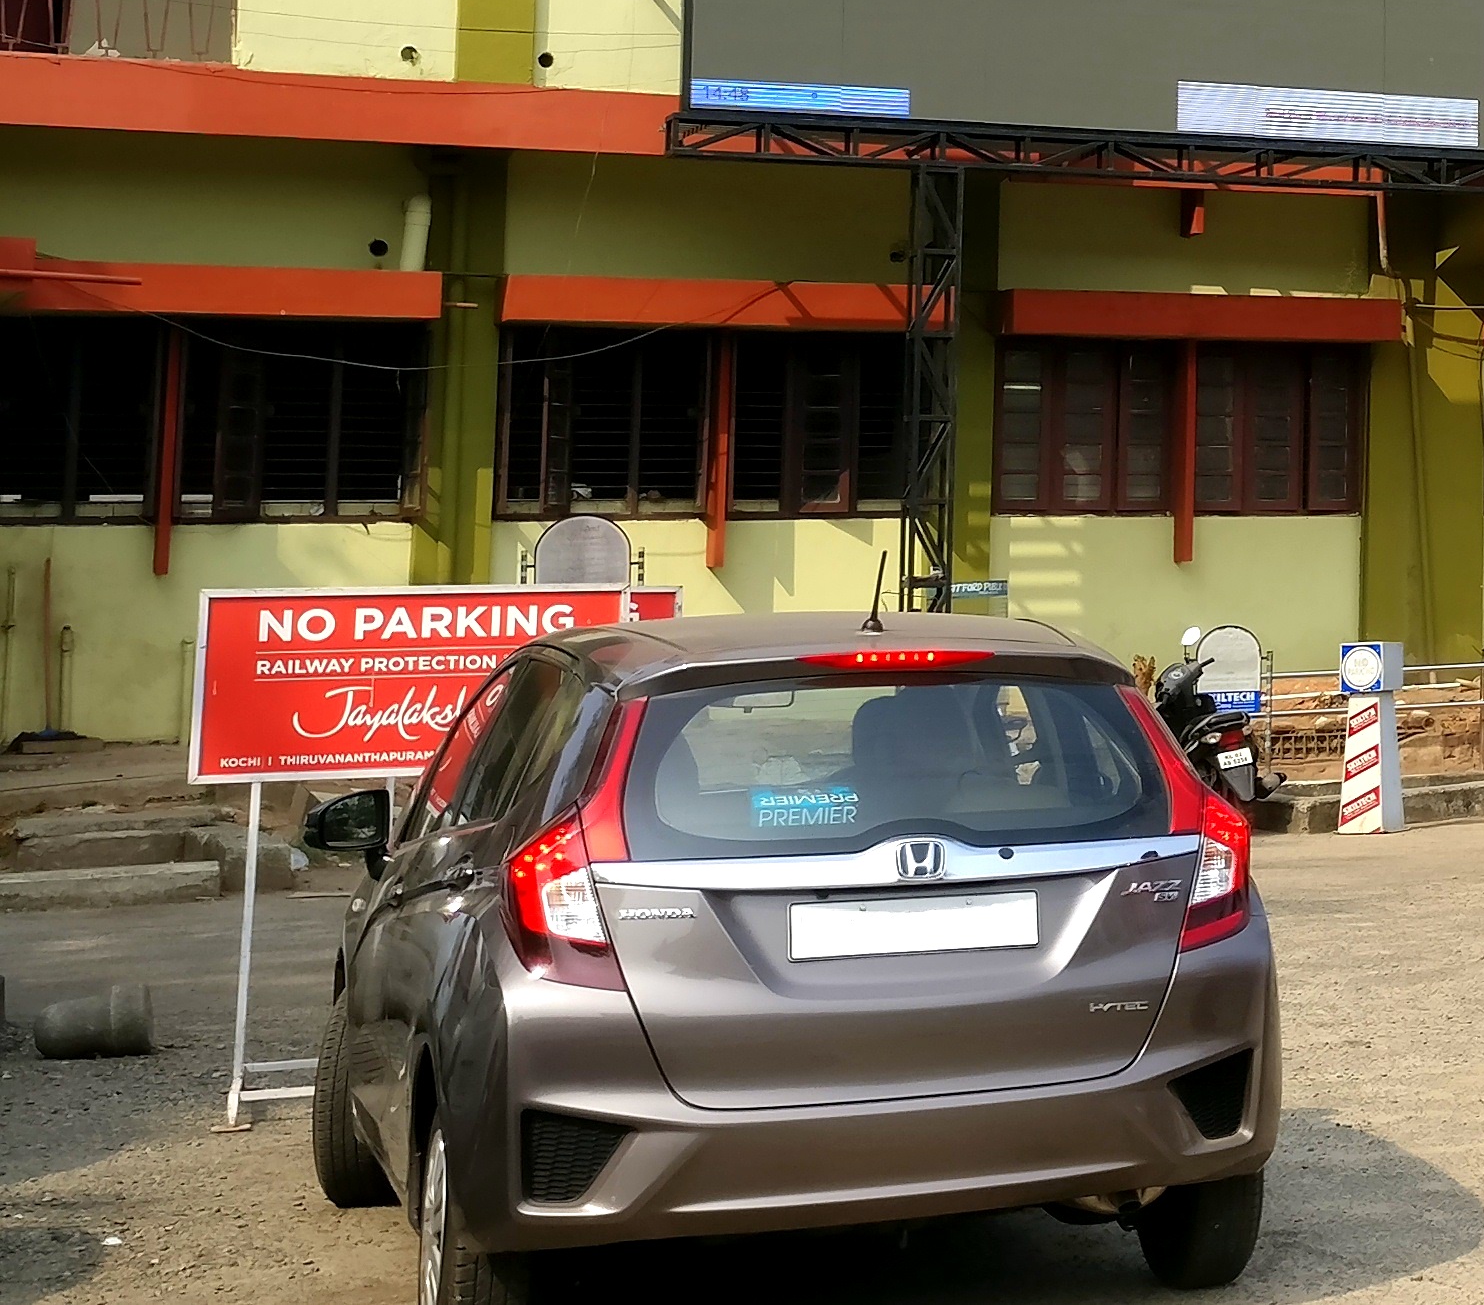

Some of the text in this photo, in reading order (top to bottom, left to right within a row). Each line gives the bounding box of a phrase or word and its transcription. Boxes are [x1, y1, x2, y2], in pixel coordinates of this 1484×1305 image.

[259, 604, 574, 642] NO PARKING
[256, 653, 497, 675] RAILWAY PROTECTION
[220, 757, 261, 768] KOCHI
[279, 751, 435, 766] THIRUVANANTHAPURAM
[758, 806, 858, 827] PREMIER
[1120, 879, 1183, 897] JAZZ
[618, 907, 697, 921] HONDA
